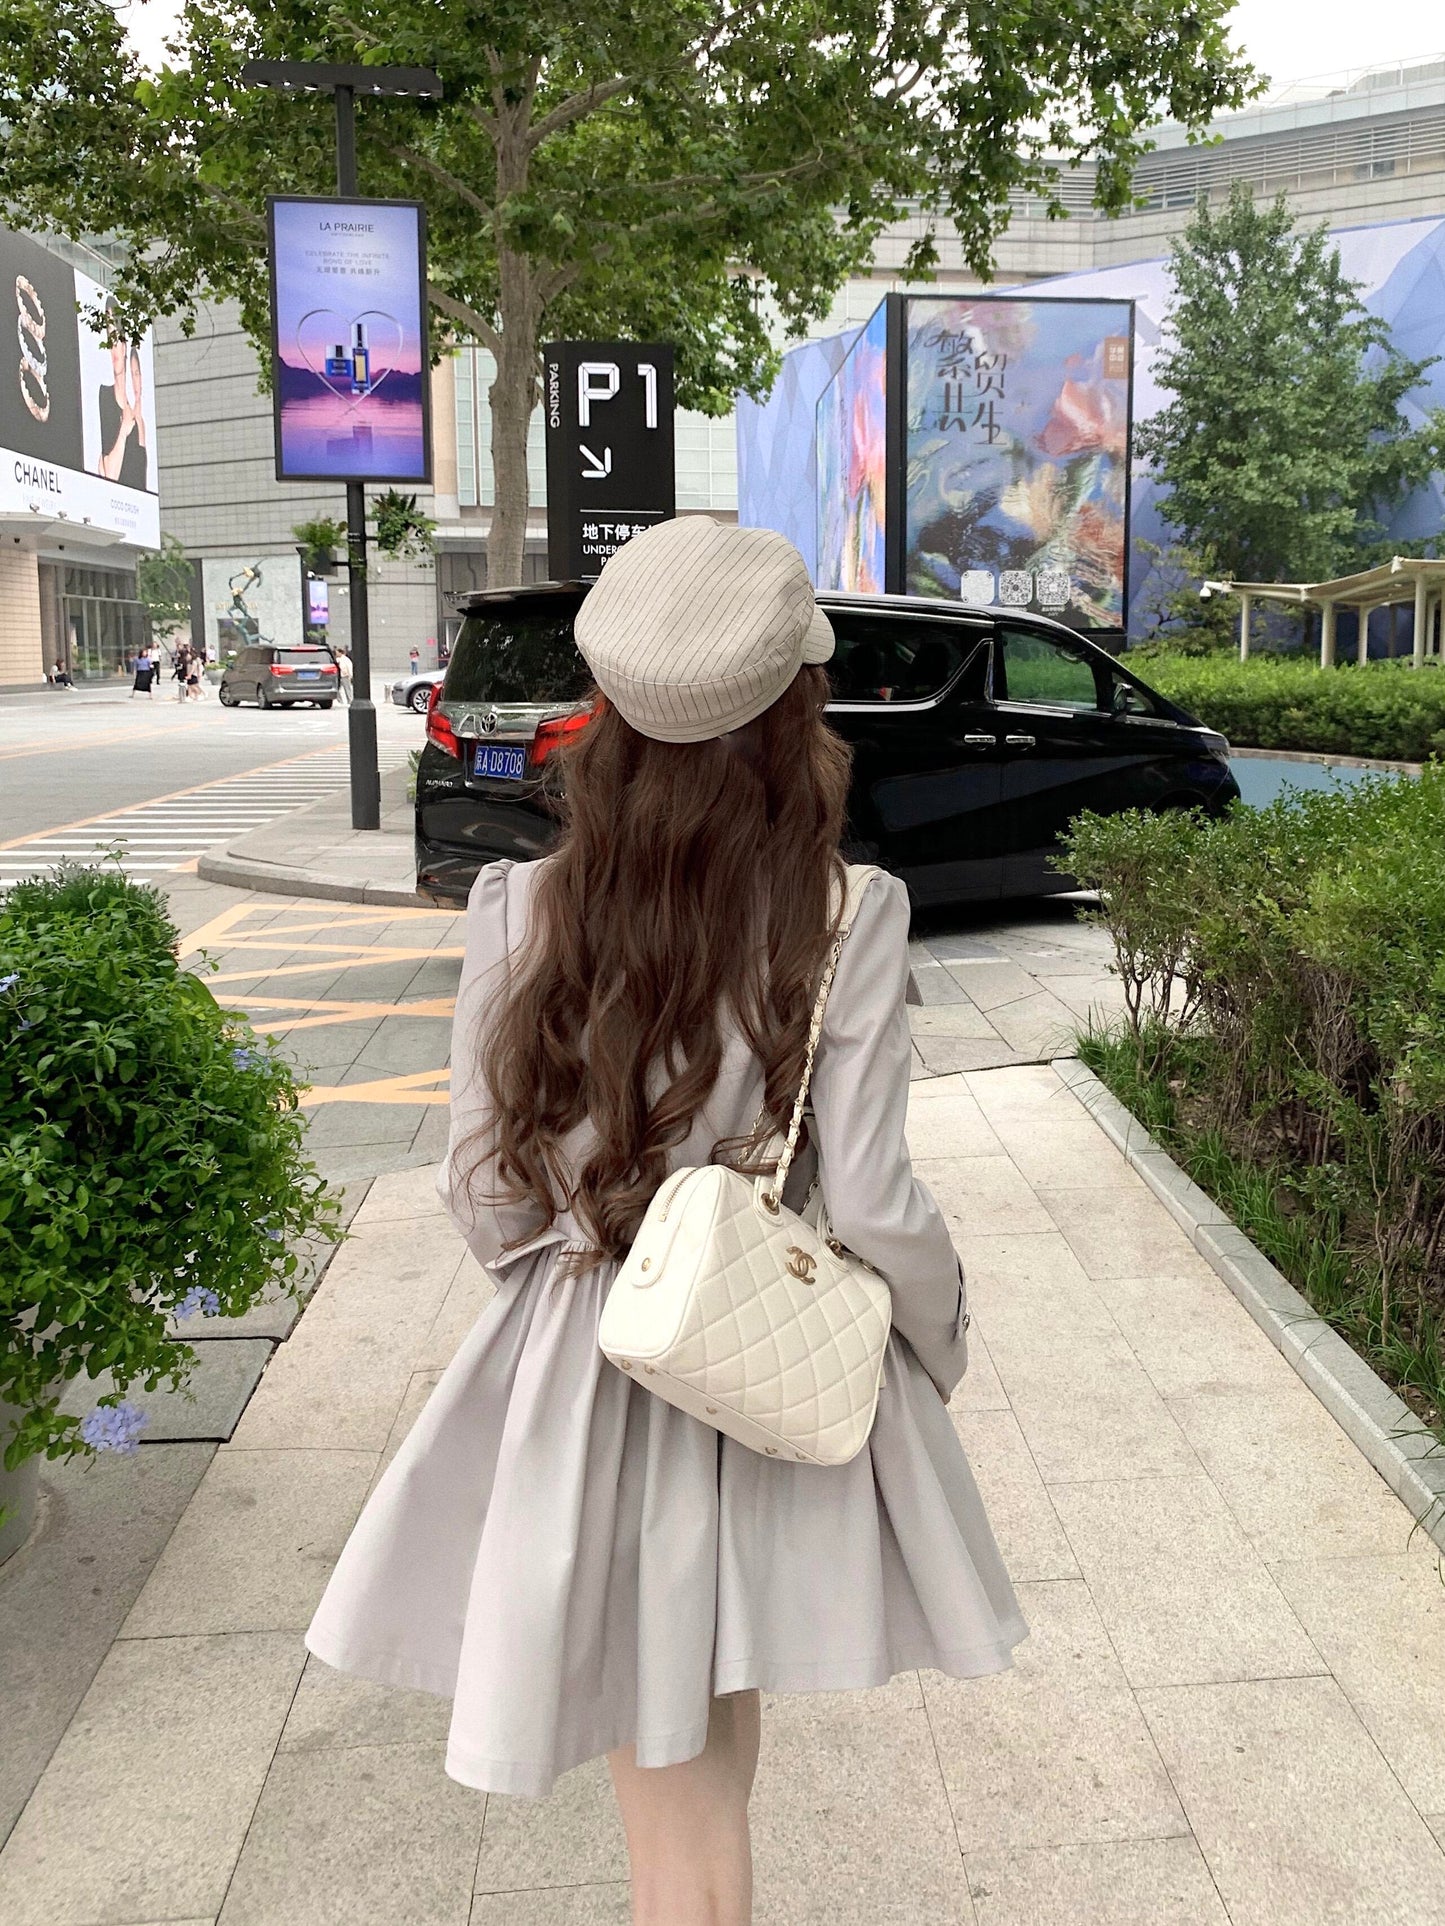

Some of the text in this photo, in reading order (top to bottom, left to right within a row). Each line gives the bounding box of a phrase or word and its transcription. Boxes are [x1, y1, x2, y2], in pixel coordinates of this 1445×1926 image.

[319, 222, 375, 233] LA PRAIRIE
[548, 362, 561, 429] PARKING
[577, 361, 658, 429] P1
[14, 460, 62, 493] CHANEL
[582, 523, 653, 540] 地下停车
